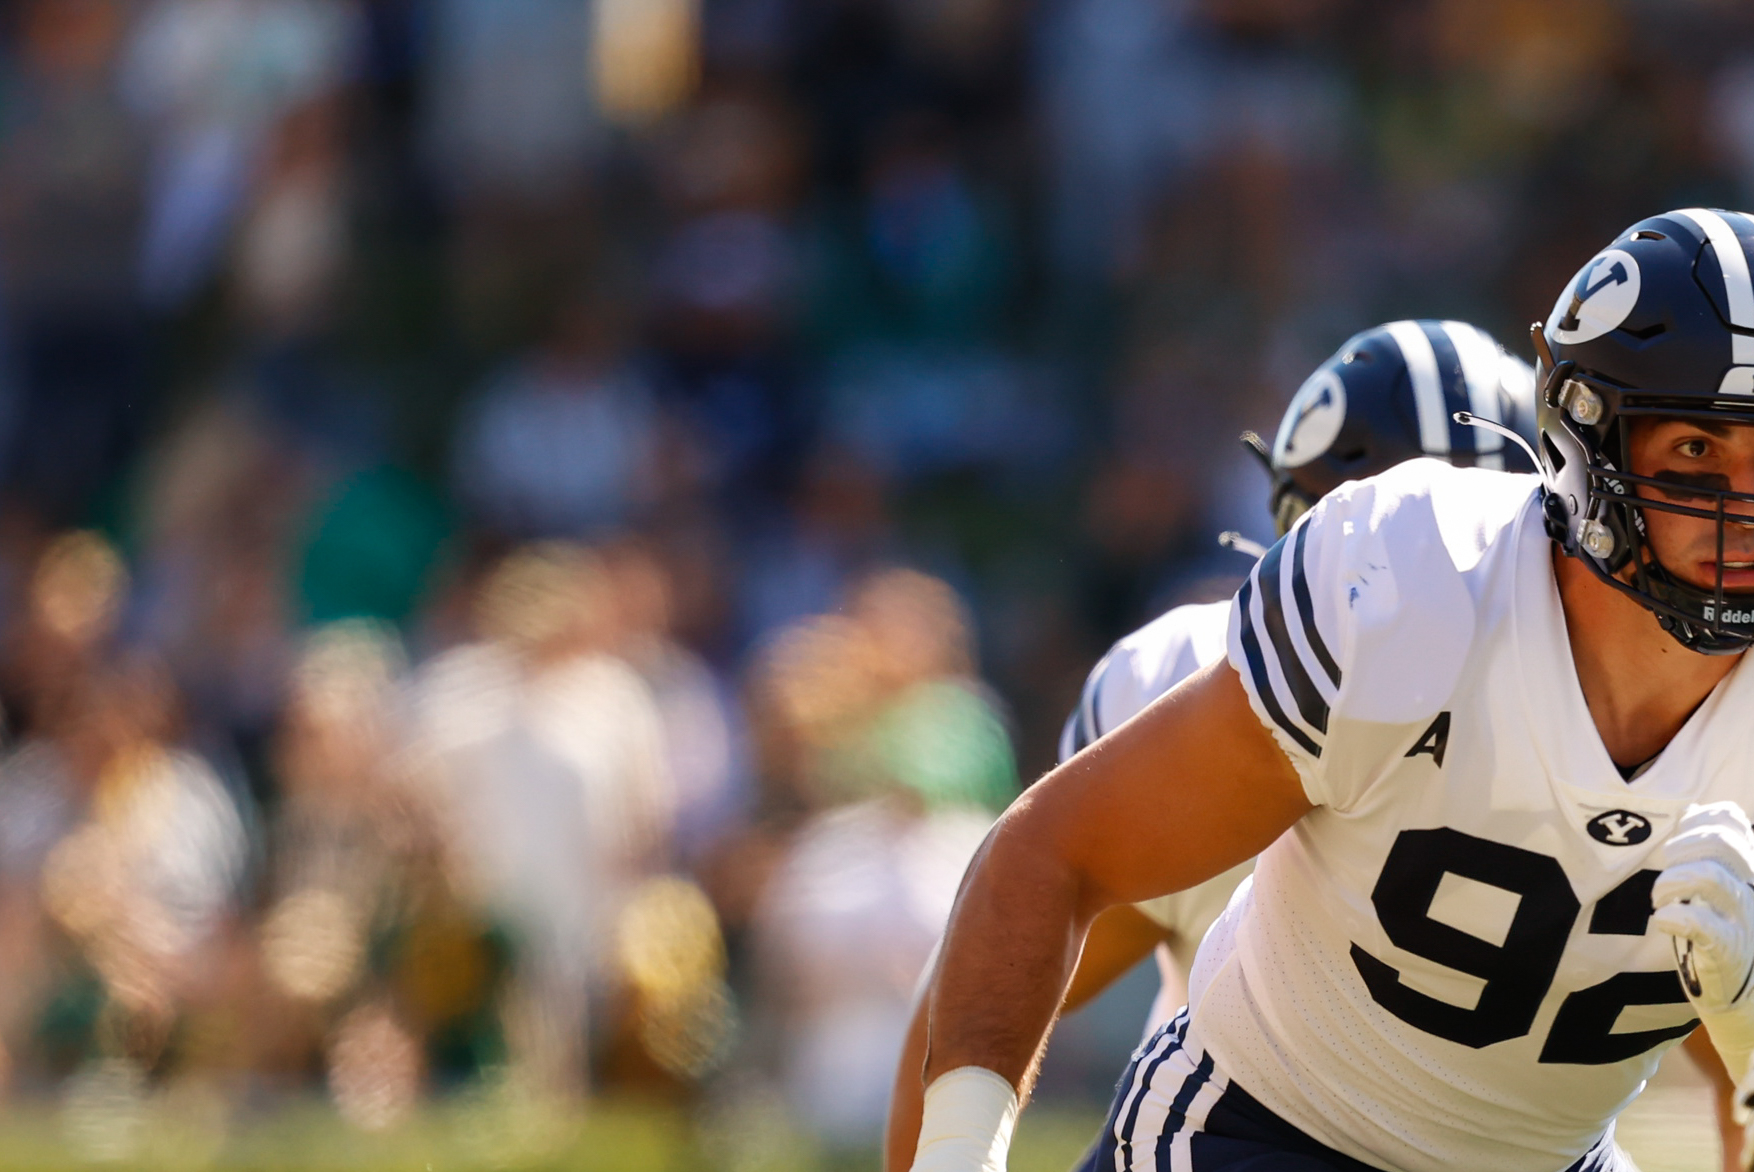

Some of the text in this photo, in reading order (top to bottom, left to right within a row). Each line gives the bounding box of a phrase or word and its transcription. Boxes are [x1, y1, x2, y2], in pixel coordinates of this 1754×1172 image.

[1557, 256, 1629, 332] Y
[1403, 711, 1451, 770] A
[1597, 812, 1645, 844] Y
[1349, 827, 1701, 1065] 92
